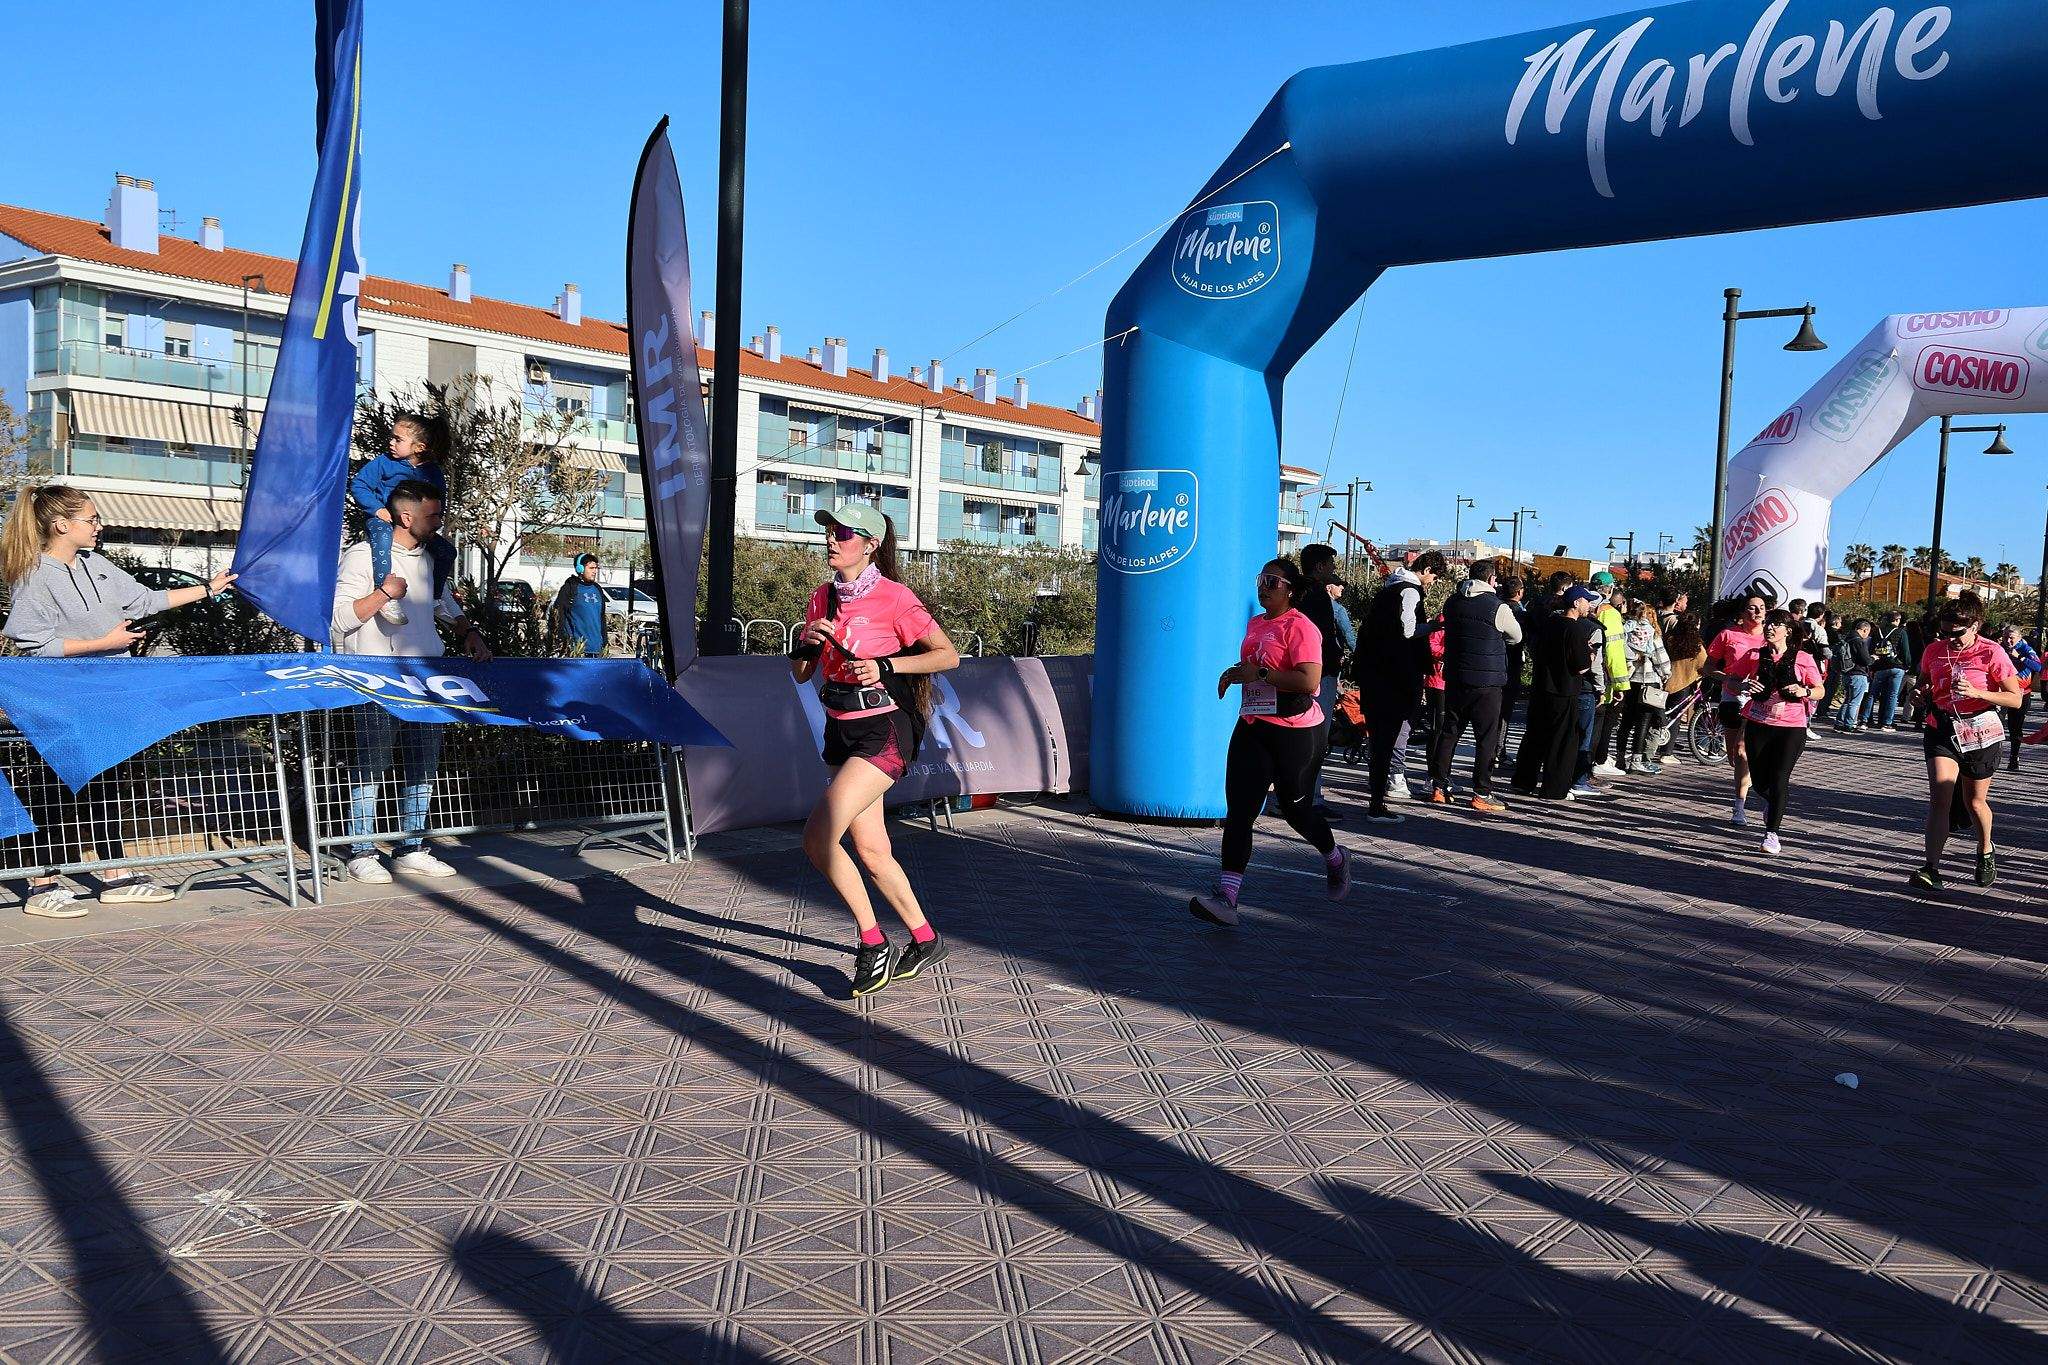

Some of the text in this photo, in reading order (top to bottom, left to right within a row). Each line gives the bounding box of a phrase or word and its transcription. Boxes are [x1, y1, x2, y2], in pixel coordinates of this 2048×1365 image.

[1504, 0, 1952, 198] Marlene
[1180, 224, 1271, 275] Marlene
[1181, 271, 1266, 293] HIJA DE LOS ALPES
[1906, 310, 2000, 332] COSMO
[1819, 357, 1889, 433] COSMO
[1924, 351, 2020, 394] COSMO
[642, 313, 687, 501] IMR
[1103, 493, 1189, 546] Marlene
[1725, 495, 1789, 560] COSMO
[1117, 556, 1129, 567] DE
[1129, 558, 1146, 568] LOS
[1149, 546, 1179, 566] ALPES
[922, 763, 938, 776] DE
[937, 760, 996, 774] VANGUARDIA
